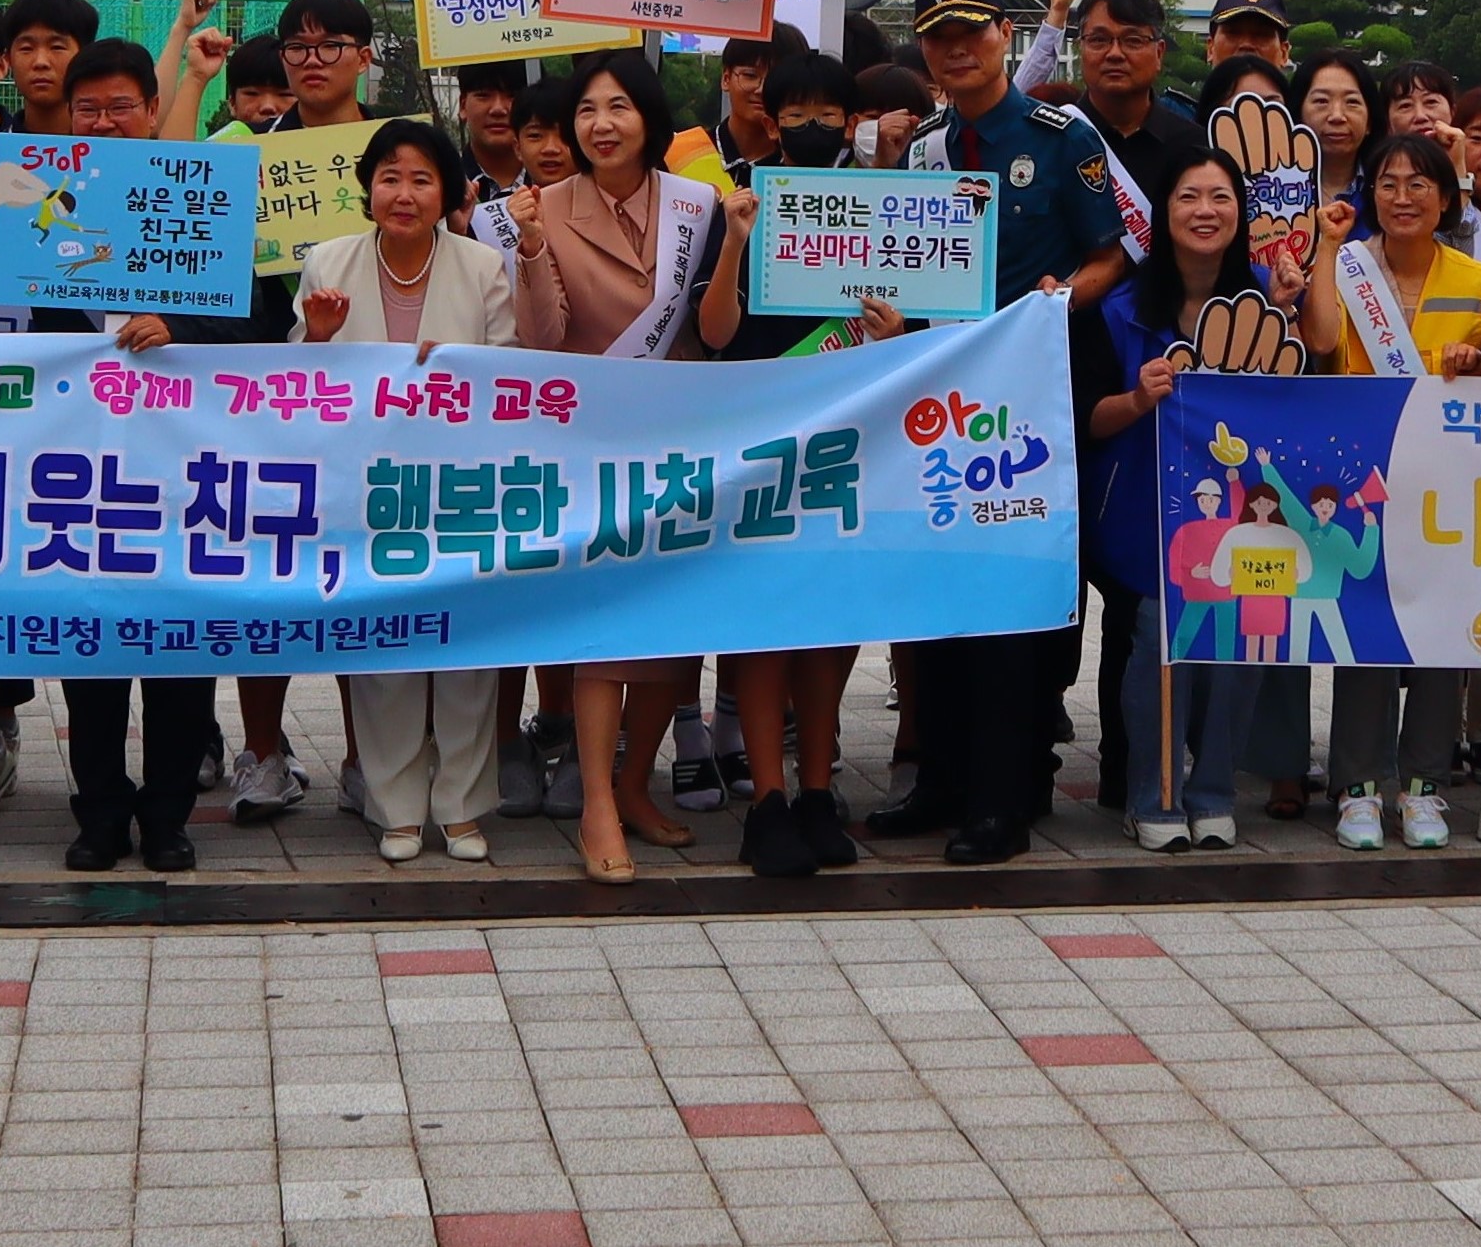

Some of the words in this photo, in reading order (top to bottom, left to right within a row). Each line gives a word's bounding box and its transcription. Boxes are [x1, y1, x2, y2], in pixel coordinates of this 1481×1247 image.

[631, 1, 684, 18] 사천중학교
[501, 27, 554, 43] 사천중학교
[20, 142, 91, 172] STOP
[125, 187, 173, 214] 싫은
[183, 188, 232, 216] 일은
[256, 190, 322, 223] 실마다
[672, 199, 703, 217] STOP
[777, 194, 871, 228] 폭력없는
[878, 195, 973, 229] 우리학교
[140, 217, 213, 244] 친구도
[776, 234, 871, 267] 교실마다
[878, 235, 972, 270] 웃음가득
[43, 284, 130, 302] 사천교육지원청
[134, 289, 233, 307] 학교통합지원센터
[840, 285, 899, 299] 사천중학교
[90, 361, 193, 415] 함께
[214, 370, 353, 421] 가꾸는
[375, 372, 471, 423] 사천
[492, 377, 578, 424] 교육
[904, 390, 1008, 446] 아이
[27, 451, 162, 574] 웃는
[183, 451, 341, 594] 친구,
[366, 456, 568, 576] 행복한
[586, 452, 715, 560] 사천
[733, 428, 861, 539] 교육
[972, 497, 1047, 524] 경남교육
[115, 611, 451, 657] 학교통합지원센터
